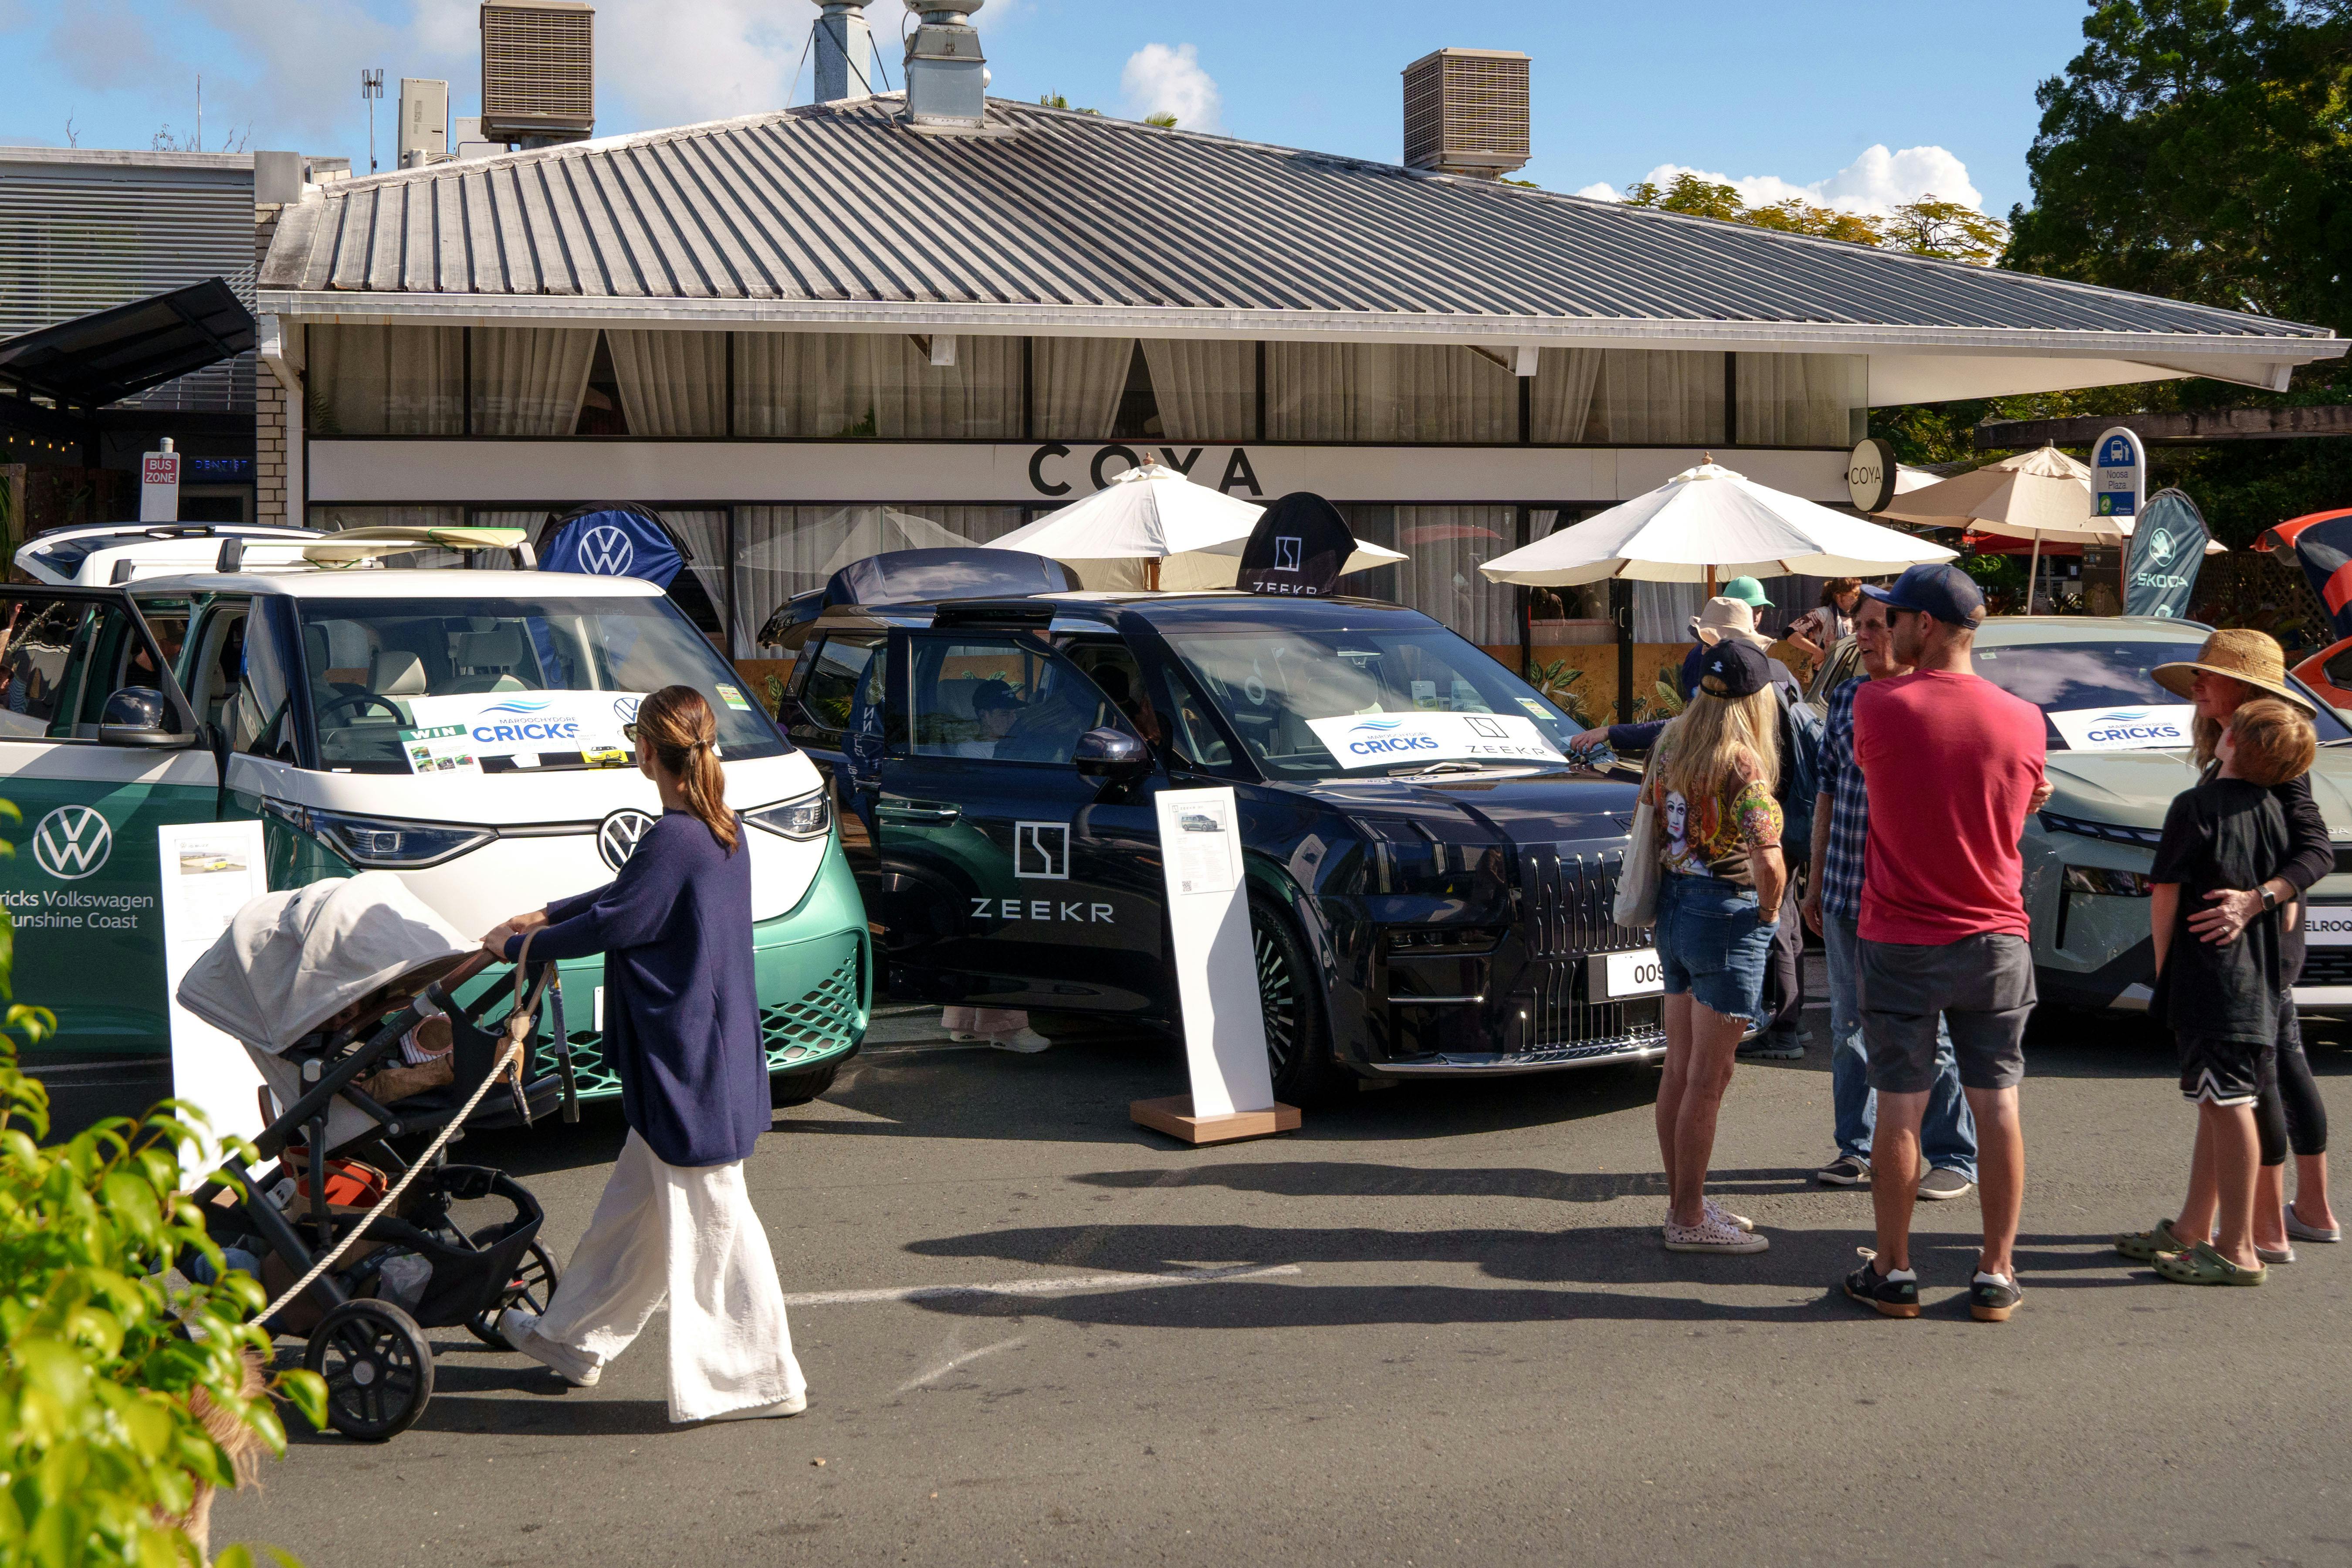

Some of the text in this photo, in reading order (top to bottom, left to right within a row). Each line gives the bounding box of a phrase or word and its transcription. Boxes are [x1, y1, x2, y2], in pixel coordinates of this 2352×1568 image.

[149, 460, 172, 470] BUS
[196, 460, 247, 469] DENTIST
[1029, 444, 1263, 496] COYA
[146, 472, 175, 483] ZONE
[1851, 466, 1882, 485] COYA
[2107, 470, 2128, 478] Noosa
[2108, 481, 2126, 489] Plaza
[410, 727, 456, 739] WIN
[473, 723, 579, 742] CRICKS
[1367, 732, 1429, 740] MAROOCHYDORE
[2087, 727, 2180, 742] CRICKS
[1350, 737, 1439, 755] CRICKS
[1465, 745, 1547, 756] ZEEKR
[43, 891, 153, 911] Volkswagen
[971, 898, 1114, 923] ZEEKR
[3, 911, 138, 928] unshine Coast
[2305, 920, 2352, 931] ELROQ
